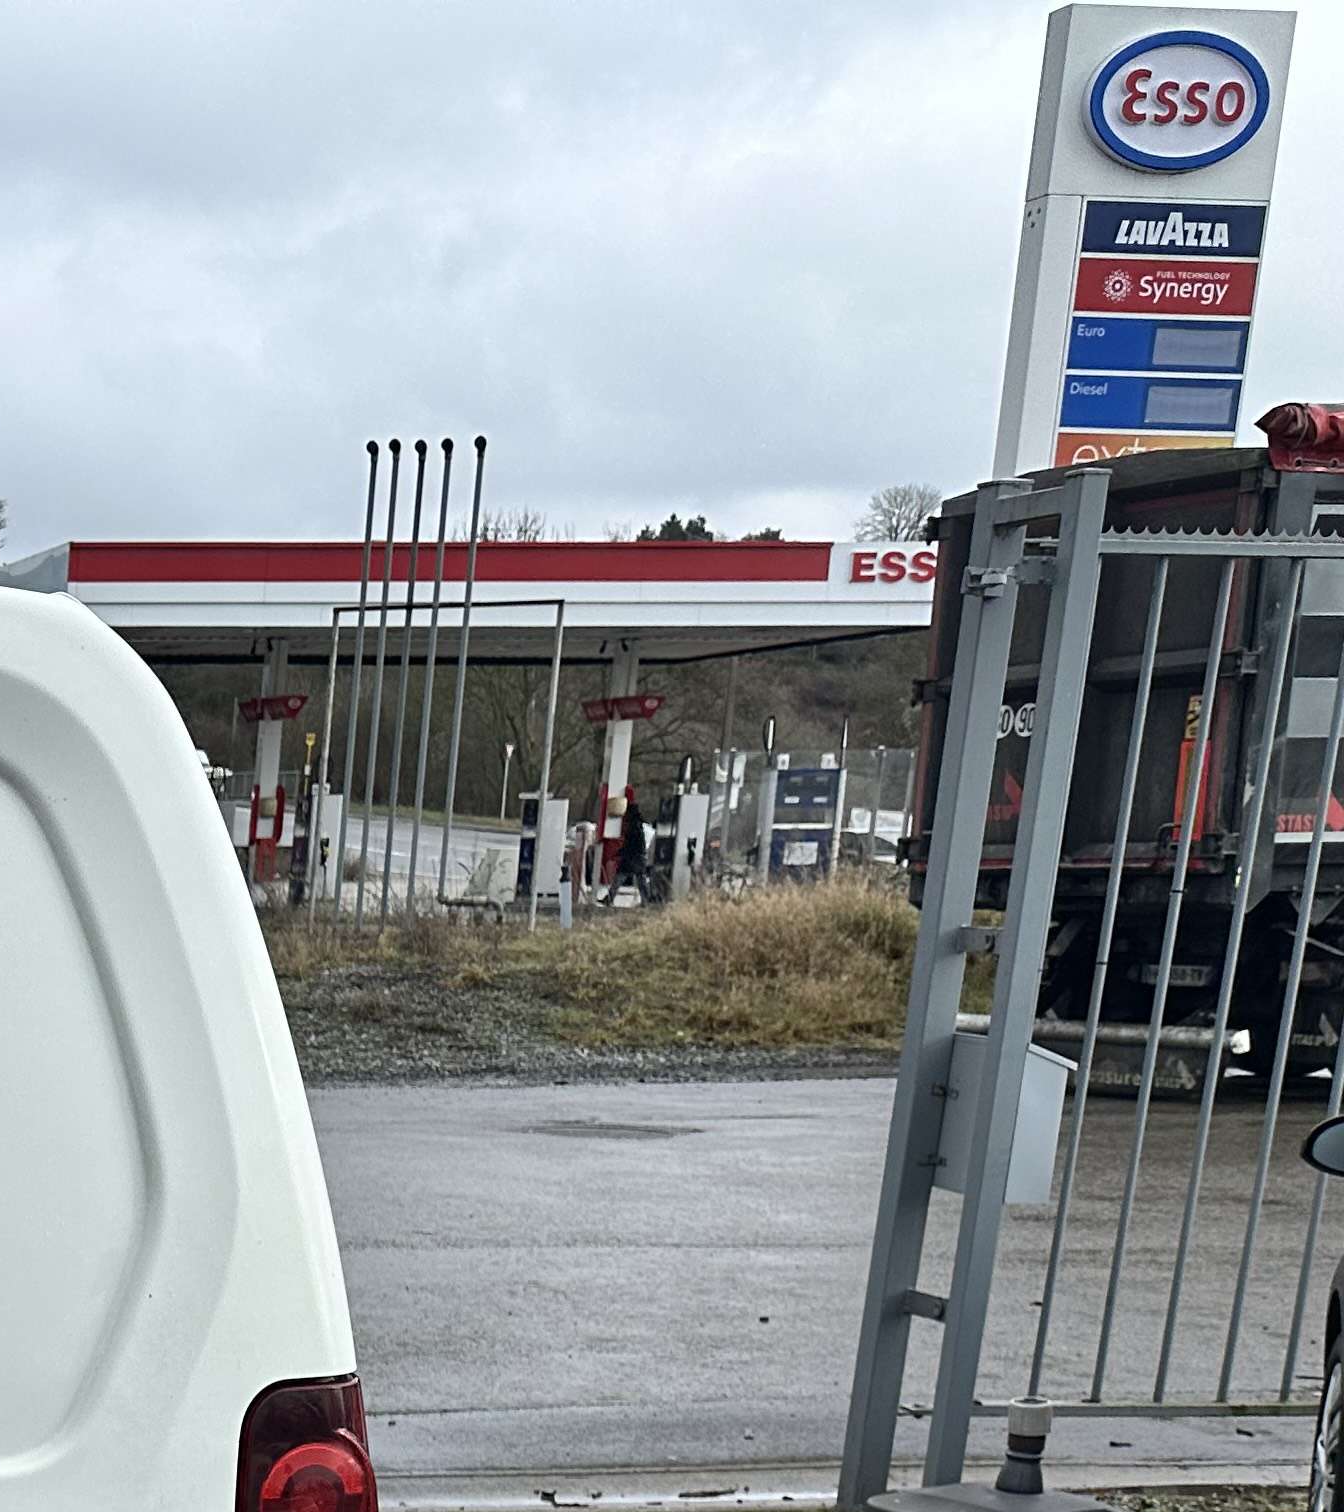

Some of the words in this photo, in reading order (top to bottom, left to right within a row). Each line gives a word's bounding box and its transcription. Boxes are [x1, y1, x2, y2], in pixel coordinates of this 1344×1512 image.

[1138, 275, 1230, 305] Synergy
[1077, 323, 1106, 337] Euro
[1069, 382, 1109, 396] Diesel
[849, 551, 938, 584] ESS
